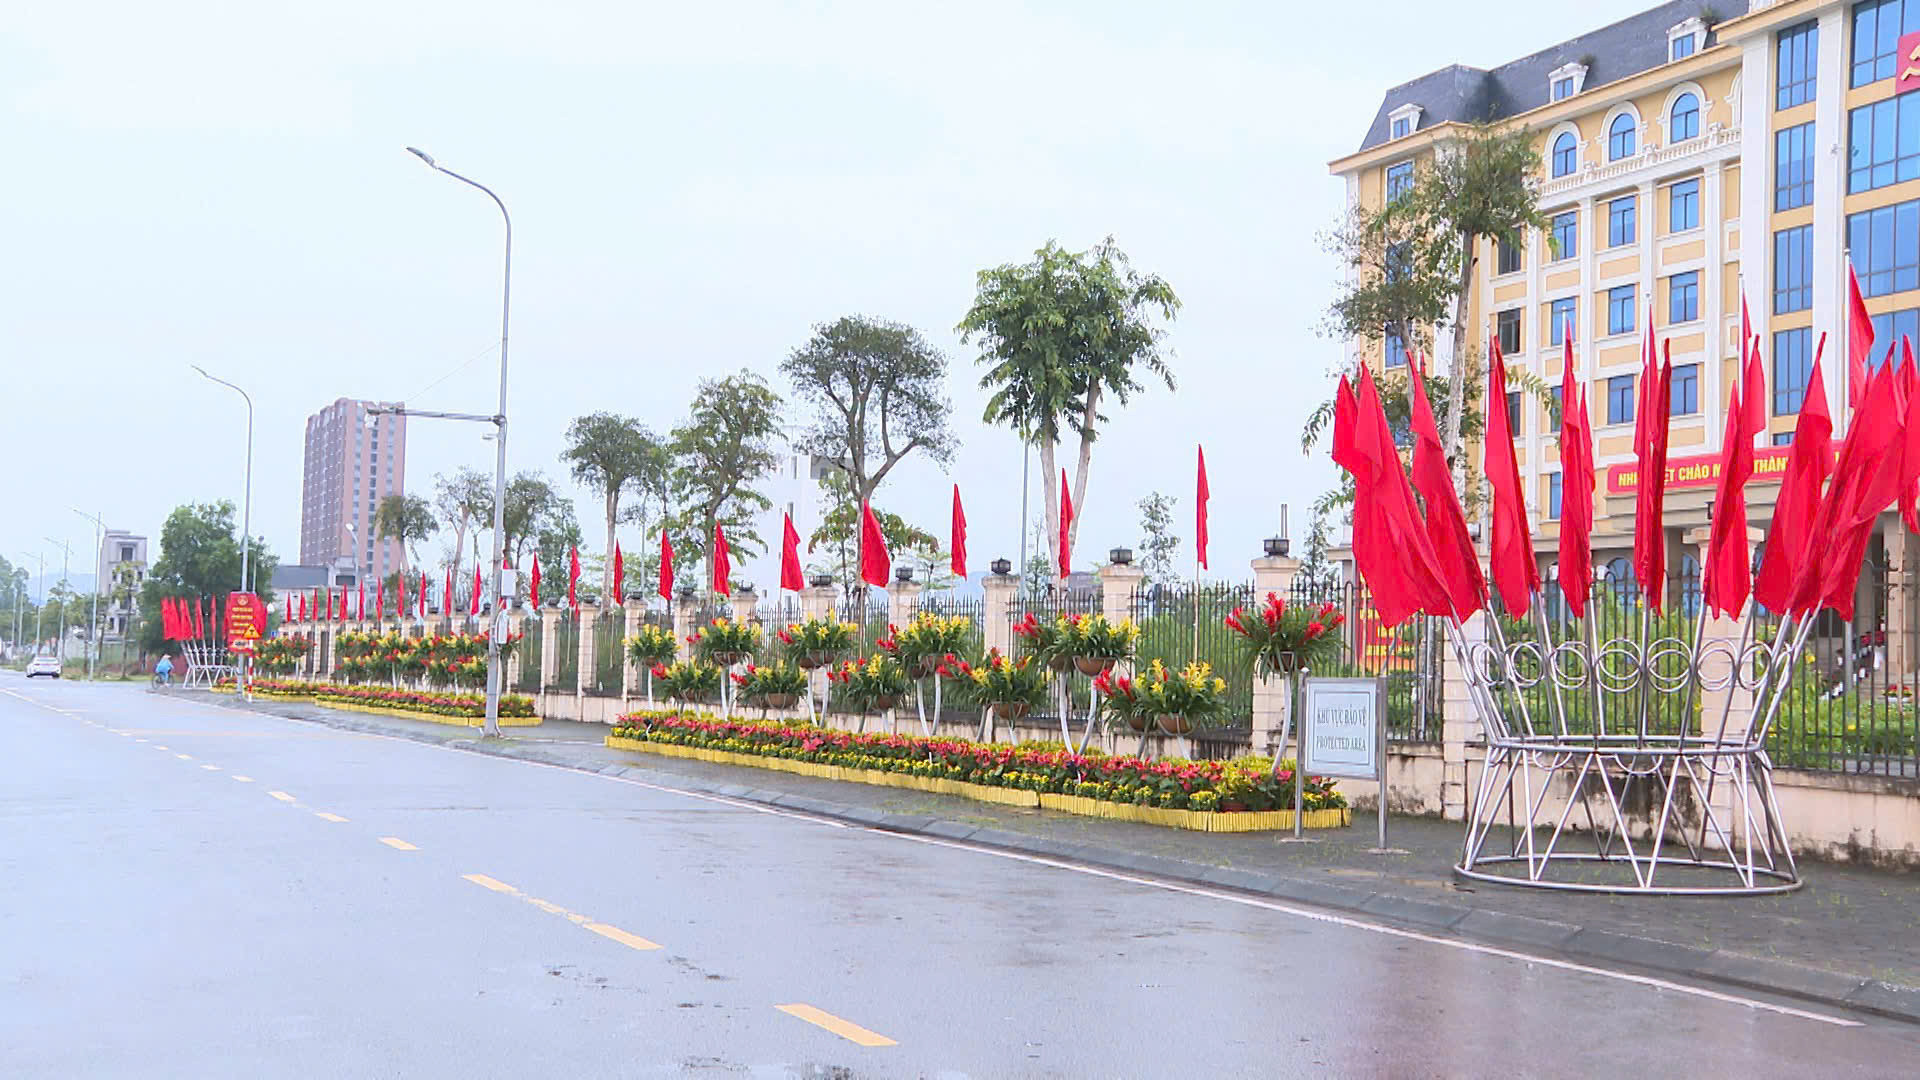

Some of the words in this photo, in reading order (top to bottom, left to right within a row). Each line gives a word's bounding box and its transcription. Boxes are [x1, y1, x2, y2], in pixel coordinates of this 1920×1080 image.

[1678, 463, 1710, 481] CHÀO
[1317, 707, 1329, 724] KHU
[1331, 706, 1344, 727] VỰC
[1344, 704, 1358, 726] BẢO
[1358, 706, 1367, 728] VỆ
[1316, 735, 1350, 750] PROTECTED
[1350, 737, 1366, 751] AREA
